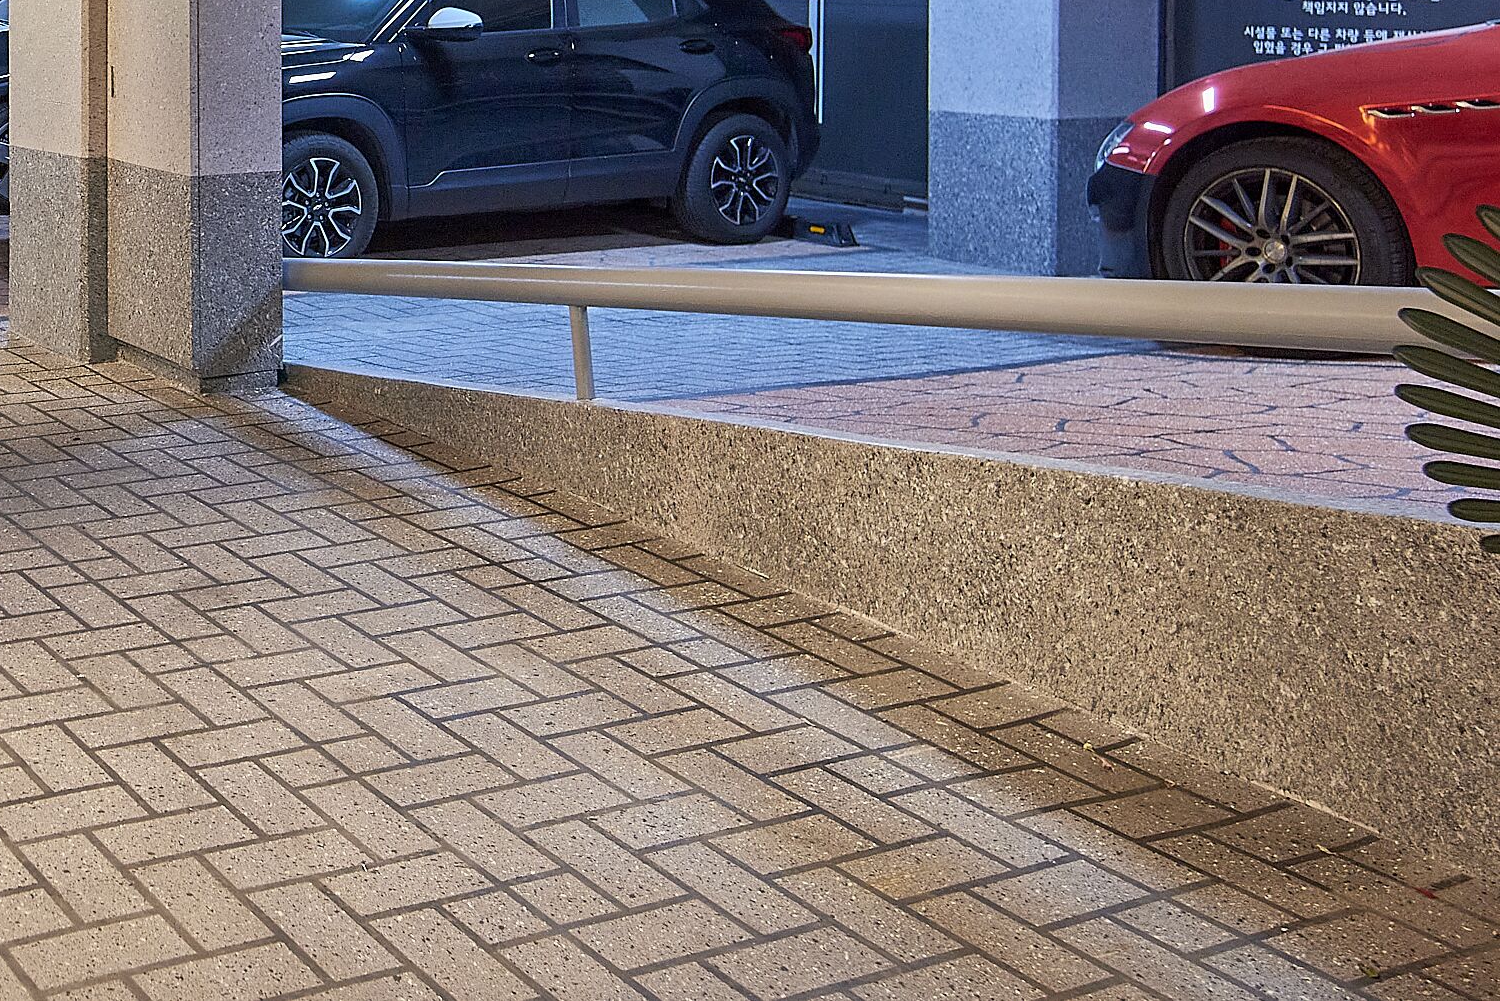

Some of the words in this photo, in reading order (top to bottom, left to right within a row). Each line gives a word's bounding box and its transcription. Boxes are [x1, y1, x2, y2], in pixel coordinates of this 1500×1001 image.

[1302, 1, 1349, 16] 책임지지
[1243, 25, 1277, 40] 시설물
[1307, 27, 1331, 42] 다른
[1335, 28, 1360, 43] 차량
[1290, 41, 1313, 56] 경우
